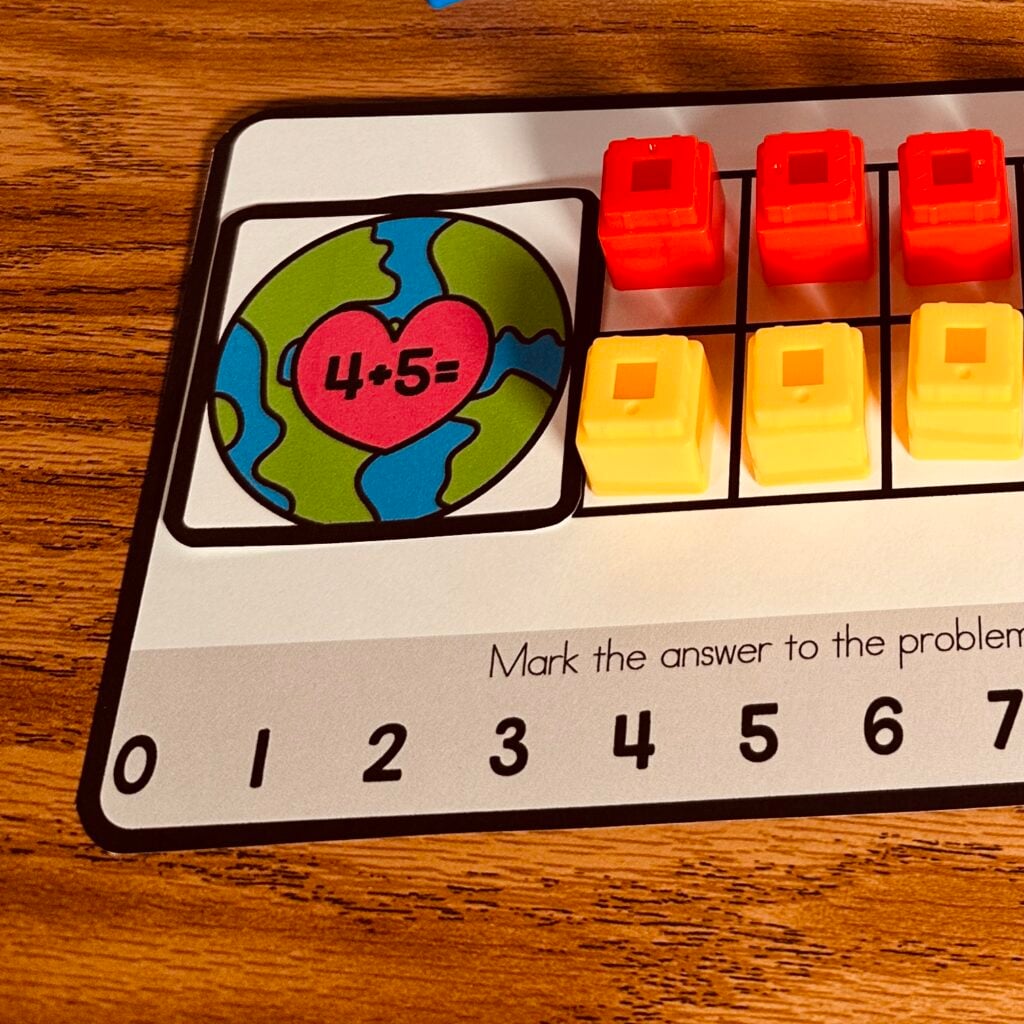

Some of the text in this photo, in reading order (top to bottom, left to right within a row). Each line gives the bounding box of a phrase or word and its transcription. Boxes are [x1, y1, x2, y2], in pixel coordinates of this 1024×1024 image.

[323, 346, 459, 401] 4+5=
[489, 640, 579, 678] Mark
[593, 638, 647, 672] the
[660, 639, 773, 669] answer
[784, 633, 819, 662] to
[832, 623, 886, 658] the
[113, 734, 157, 795] 0
[249, 728, 270, 788] 1
[361, 723, 408, 782] 2
[489, 717, 529, 777] 3
[612, 709, 655, 769] 4
[739, 703, 779, 763] 5
[863, 696, 904, 755] 6
[987, 689, 1024, 750] 7
